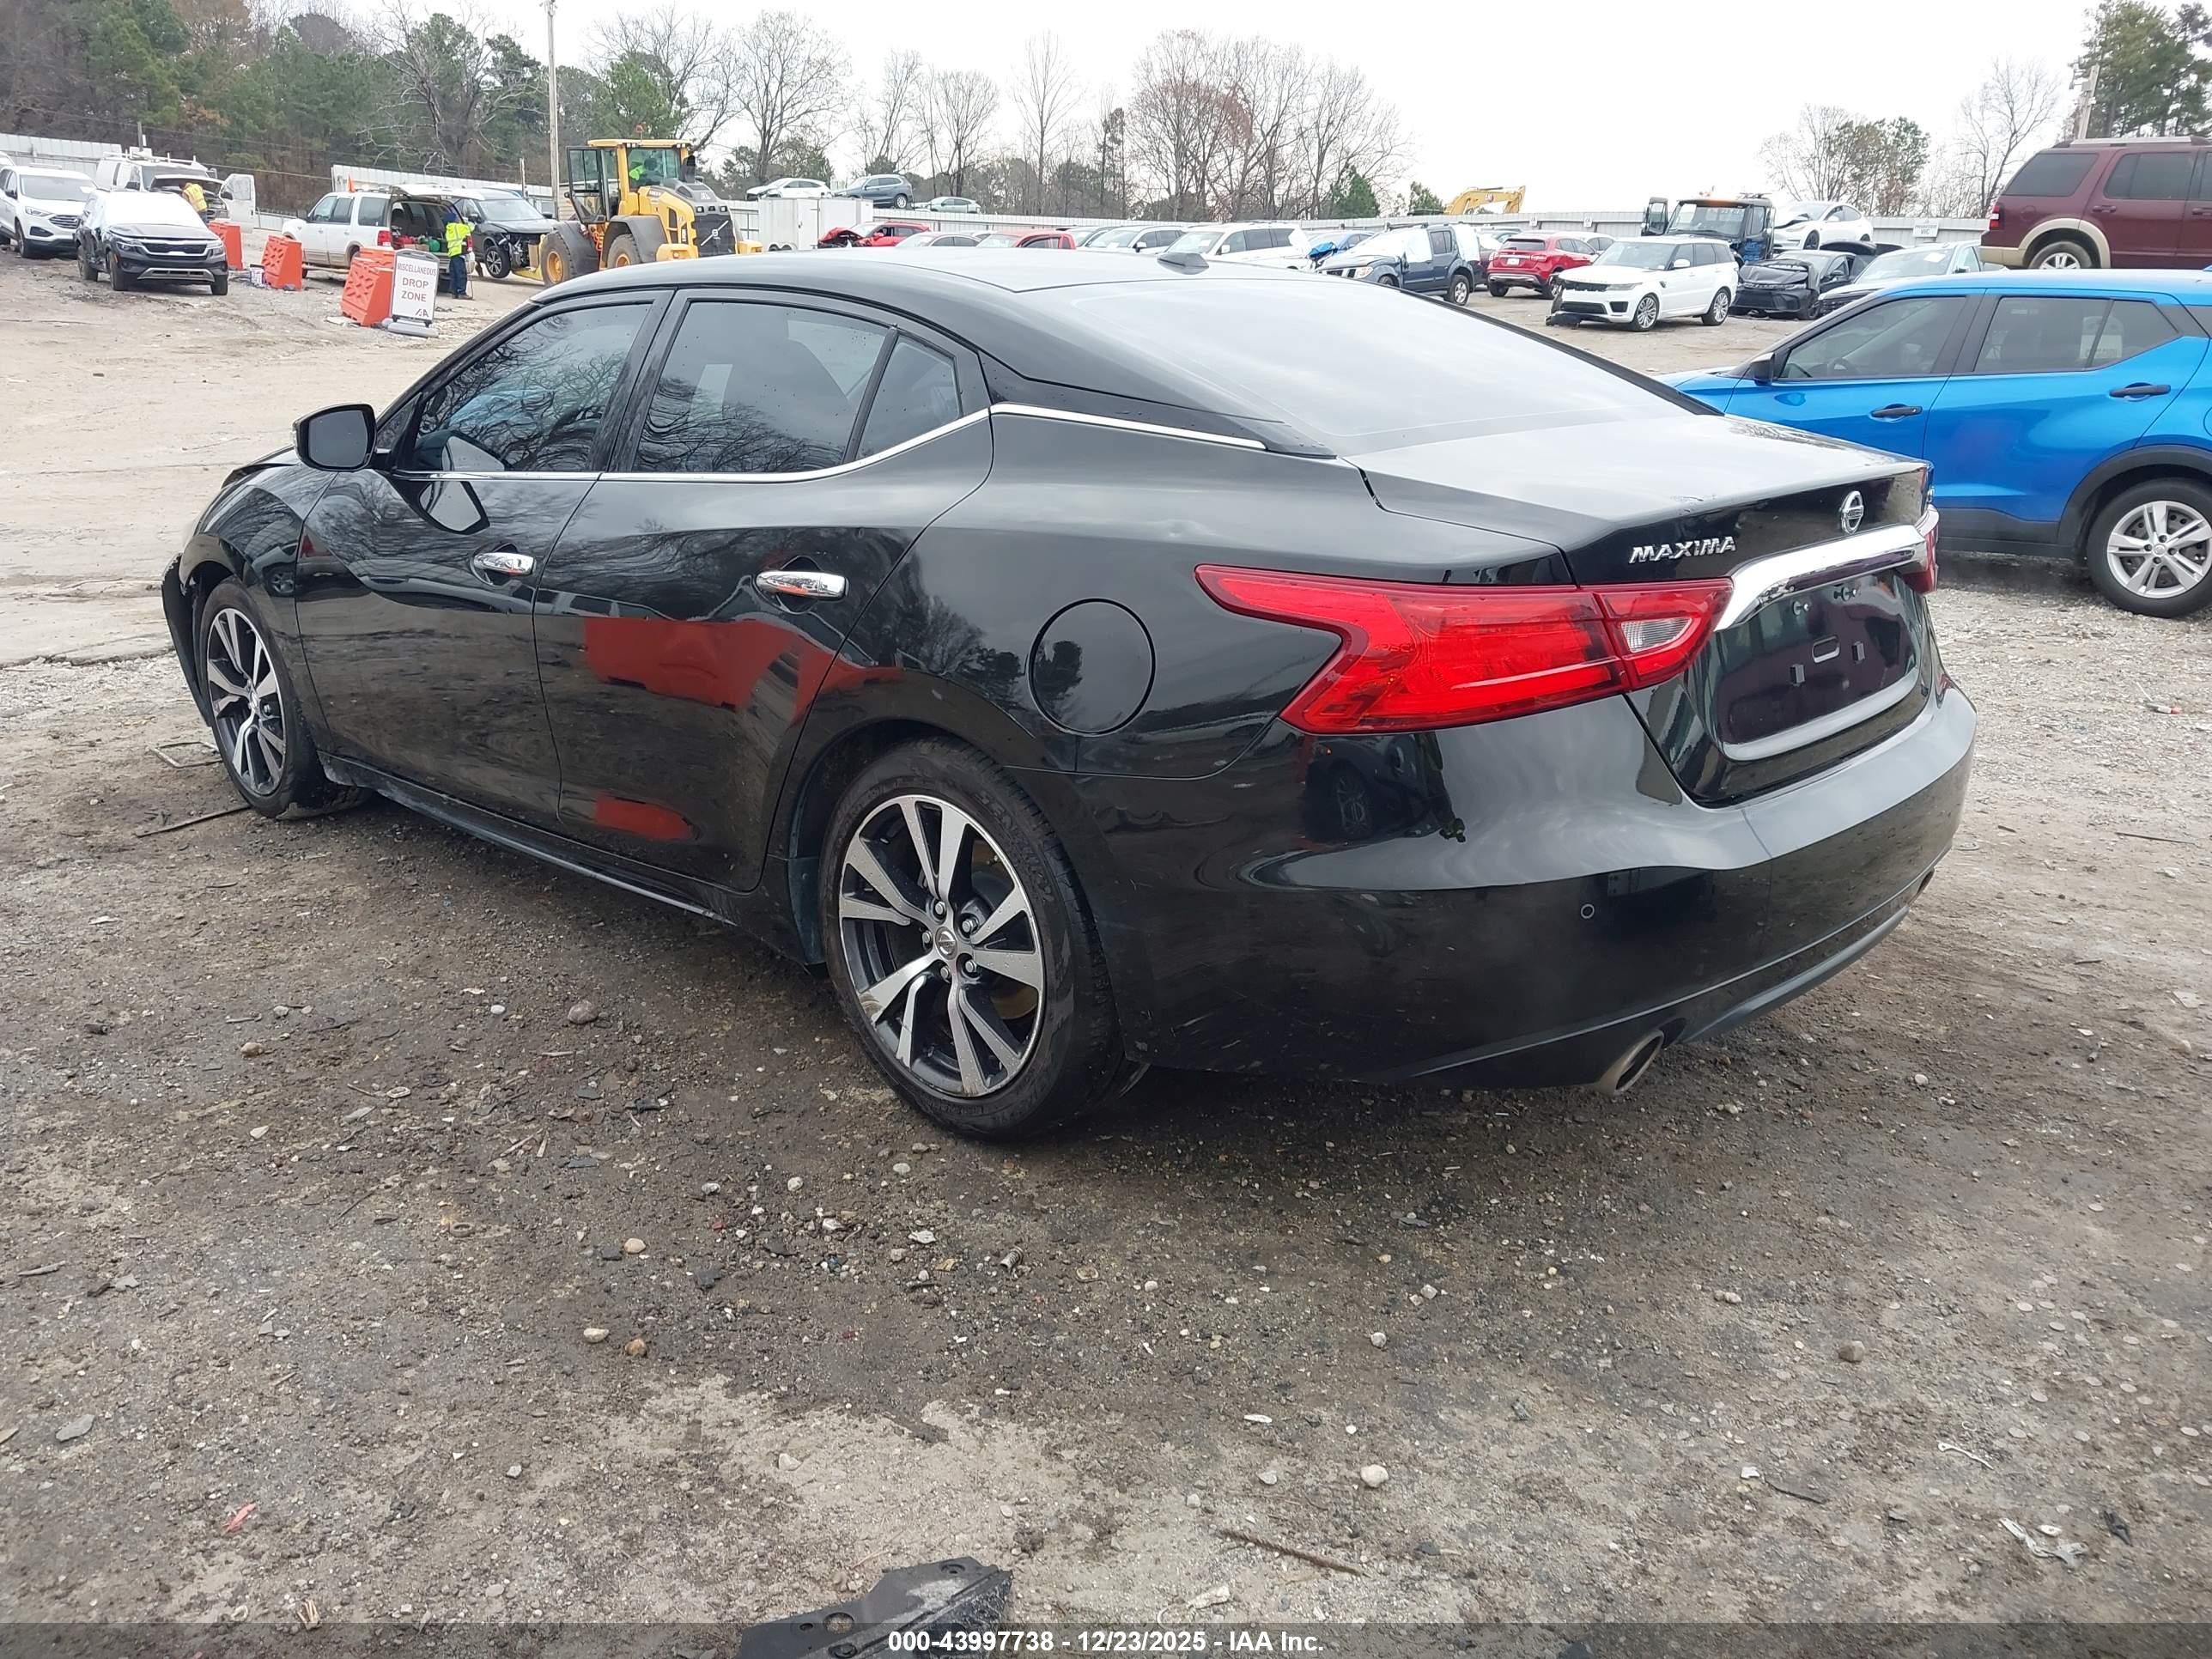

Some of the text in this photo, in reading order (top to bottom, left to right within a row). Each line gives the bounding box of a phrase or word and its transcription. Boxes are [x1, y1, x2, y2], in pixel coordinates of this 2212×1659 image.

[398, 262, 437, 276] MISCELLANEOUS
[402, 277, 429, 289] DROP
[401, 290, 427, 302] ZONE
[1628, 536, 1736, 564] MAXIMA
